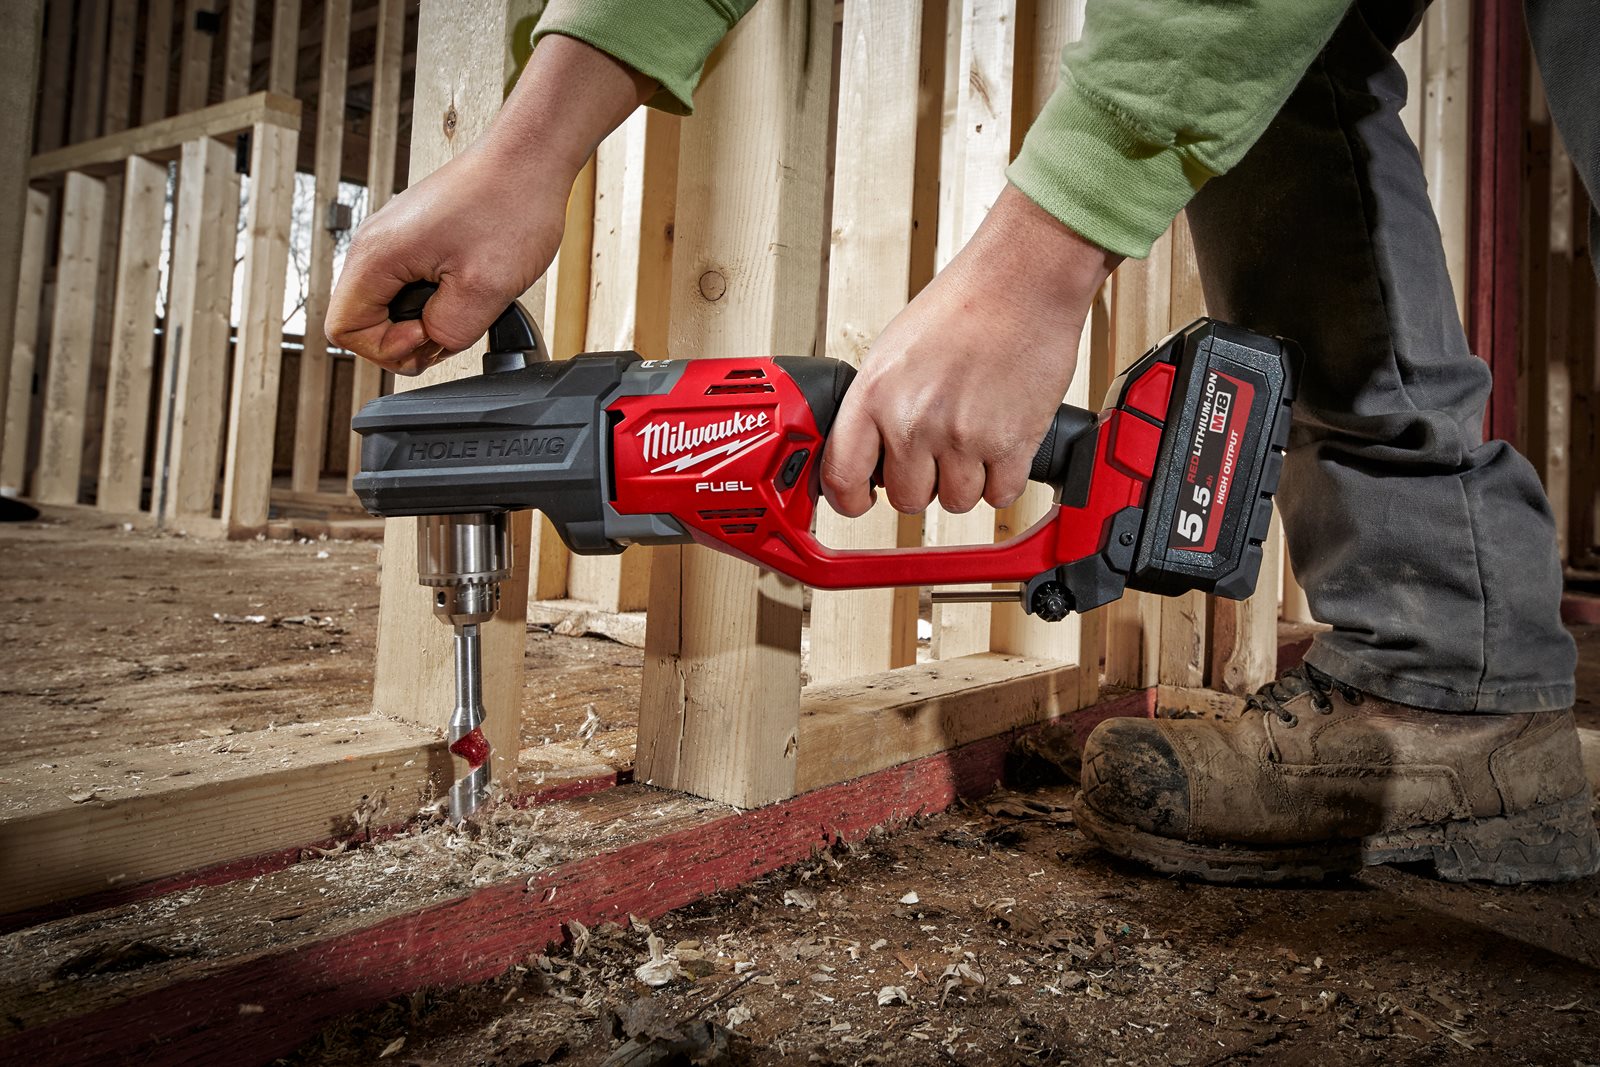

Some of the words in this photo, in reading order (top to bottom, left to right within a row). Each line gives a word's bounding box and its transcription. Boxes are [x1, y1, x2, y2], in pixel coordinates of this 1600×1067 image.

[1210, 393, 1229, 431] M18
[408, 441, 479, 462] HOLE
[486, 436, 565, 459] HAWG
[636, 411, 770, 462] Milwaukee
[695, 480, 753, 493] FUEL
[1217, 475, 1229, 505] HIGH
[1223, 430, 1239, 475] OUTPUT
[1177, 485, 1211, 542] 5.5
